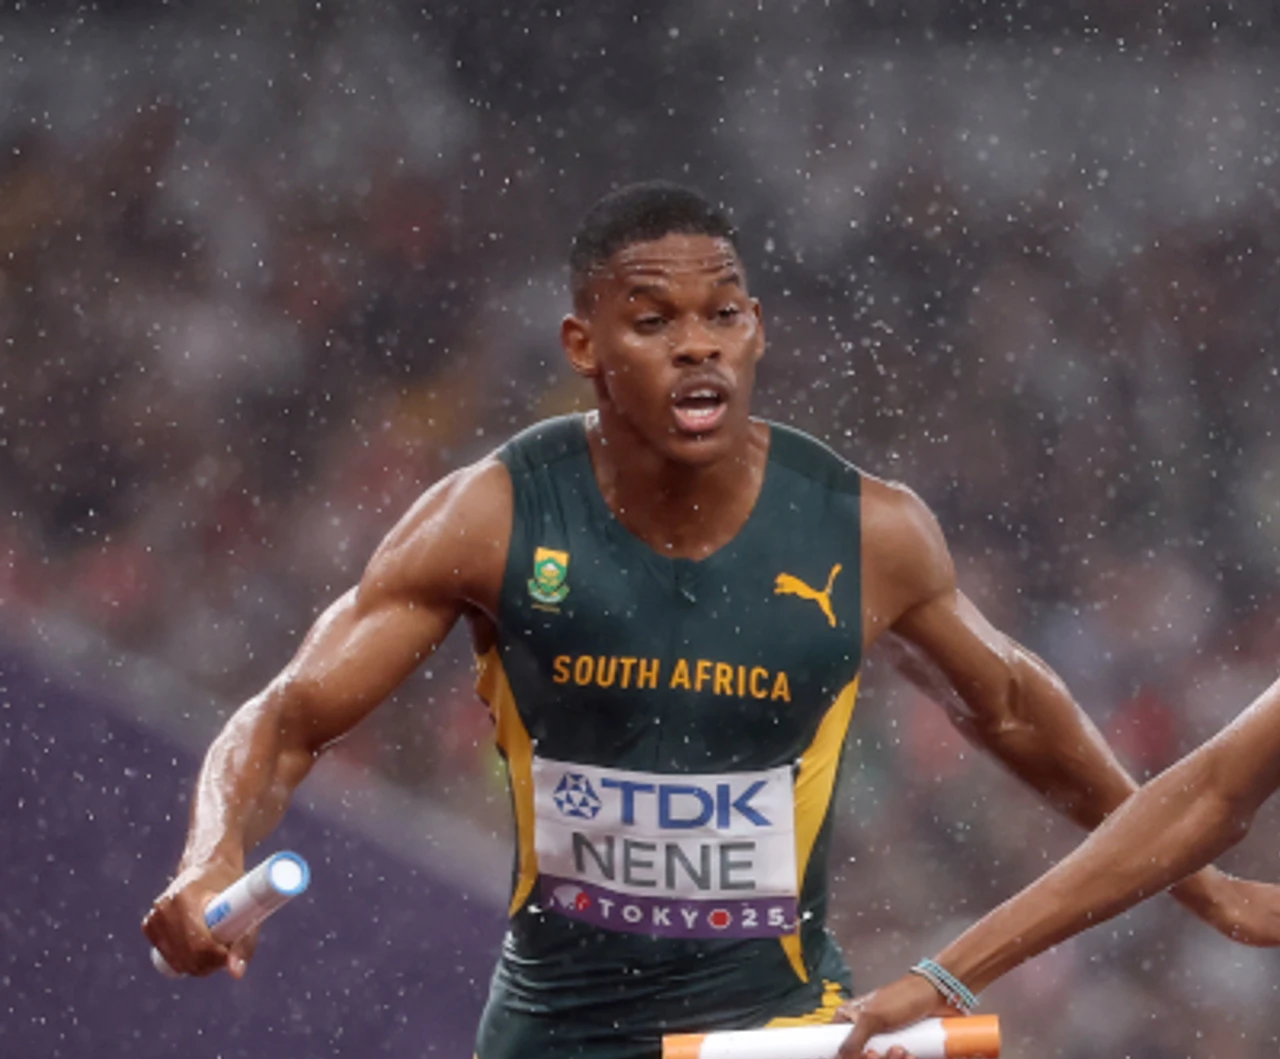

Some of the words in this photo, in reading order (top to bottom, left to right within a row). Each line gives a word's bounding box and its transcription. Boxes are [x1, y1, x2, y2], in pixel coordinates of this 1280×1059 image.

[552, 654, 660, 690] SOUTH
[669, 661, 792, 702] AFRICA
[600, 777, 773, 830] TDK
[572, 831, 757, 891] NENE
